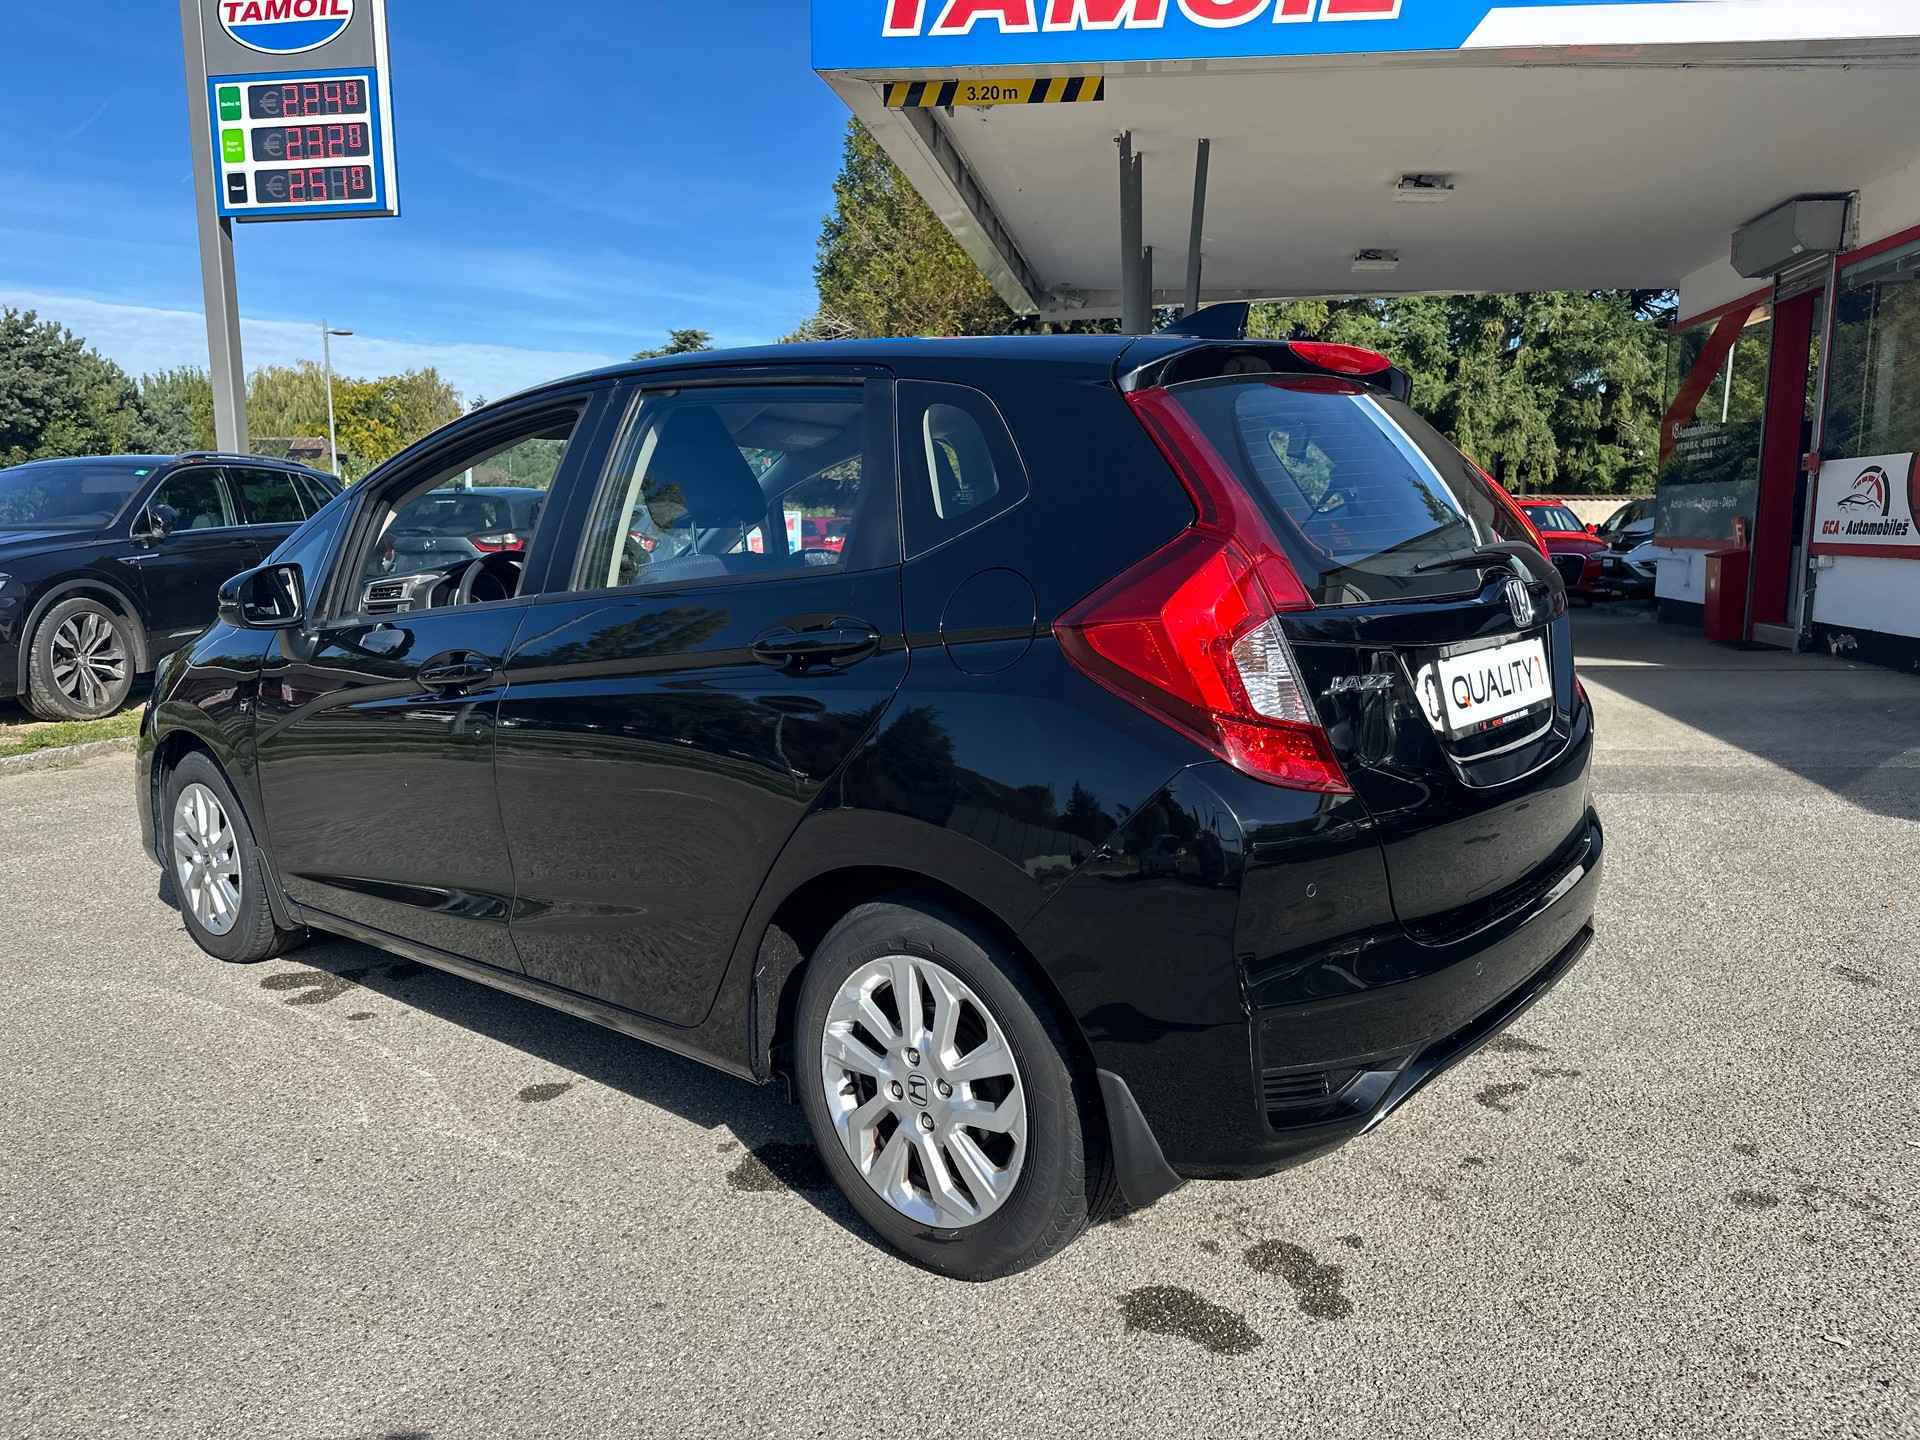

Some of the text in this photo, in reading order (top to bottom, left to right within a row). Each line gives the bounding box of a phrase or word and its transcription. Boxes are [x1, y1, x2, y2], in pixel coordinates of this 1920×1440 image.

[223, 0, 349, 22] TAMOIL
[967, 86, 1018, 101] 3.20 m
[1822, 520, 1839, 535] GCA
[1845, 519, 1910, 536] Automobiles
[1321, 672, 1395, 696] JAZZ
